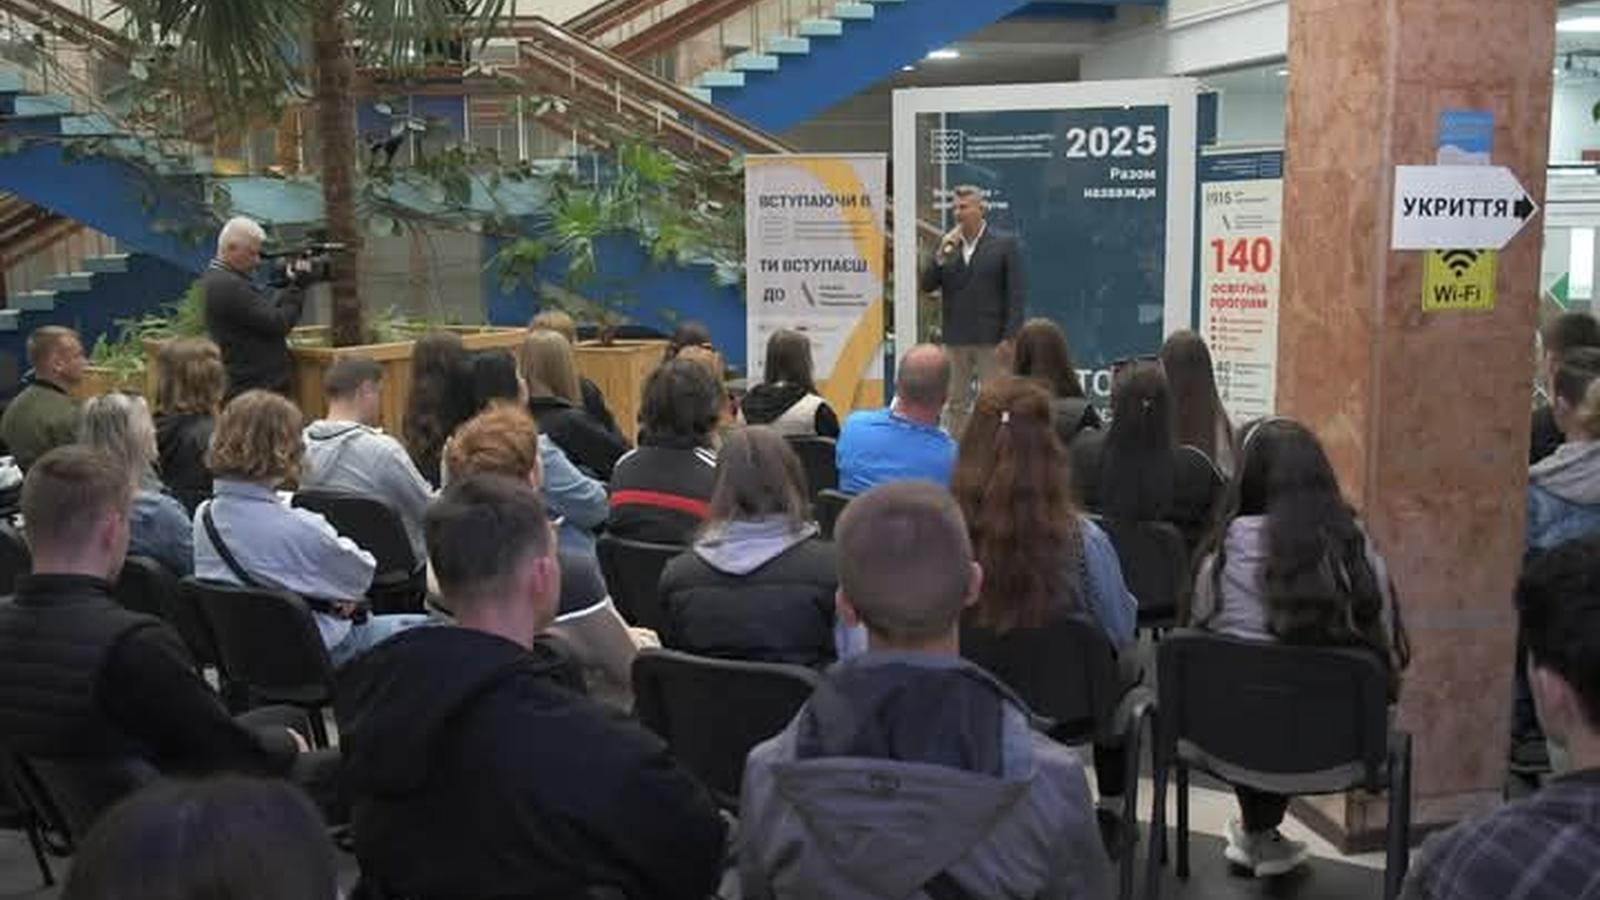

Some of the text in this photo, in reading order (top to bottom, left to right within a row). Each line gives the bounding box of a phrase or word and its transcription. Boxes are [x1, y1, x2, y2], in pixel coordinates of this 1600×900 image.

[1066, 125, 1157, 157] 2025
[1110, 167, 1156, 180] Разом
[759, 194, 857, 208] ВСТУПАЮЧИ
[1403, 197, 1508, 217] УКРИТТЯ
[1211, 237, 1273, 273] 140
[760, 259, 868, 272] ТИ ВСТУПАЄШ
[1434, 284, 1481, 302] Wi-Fi
